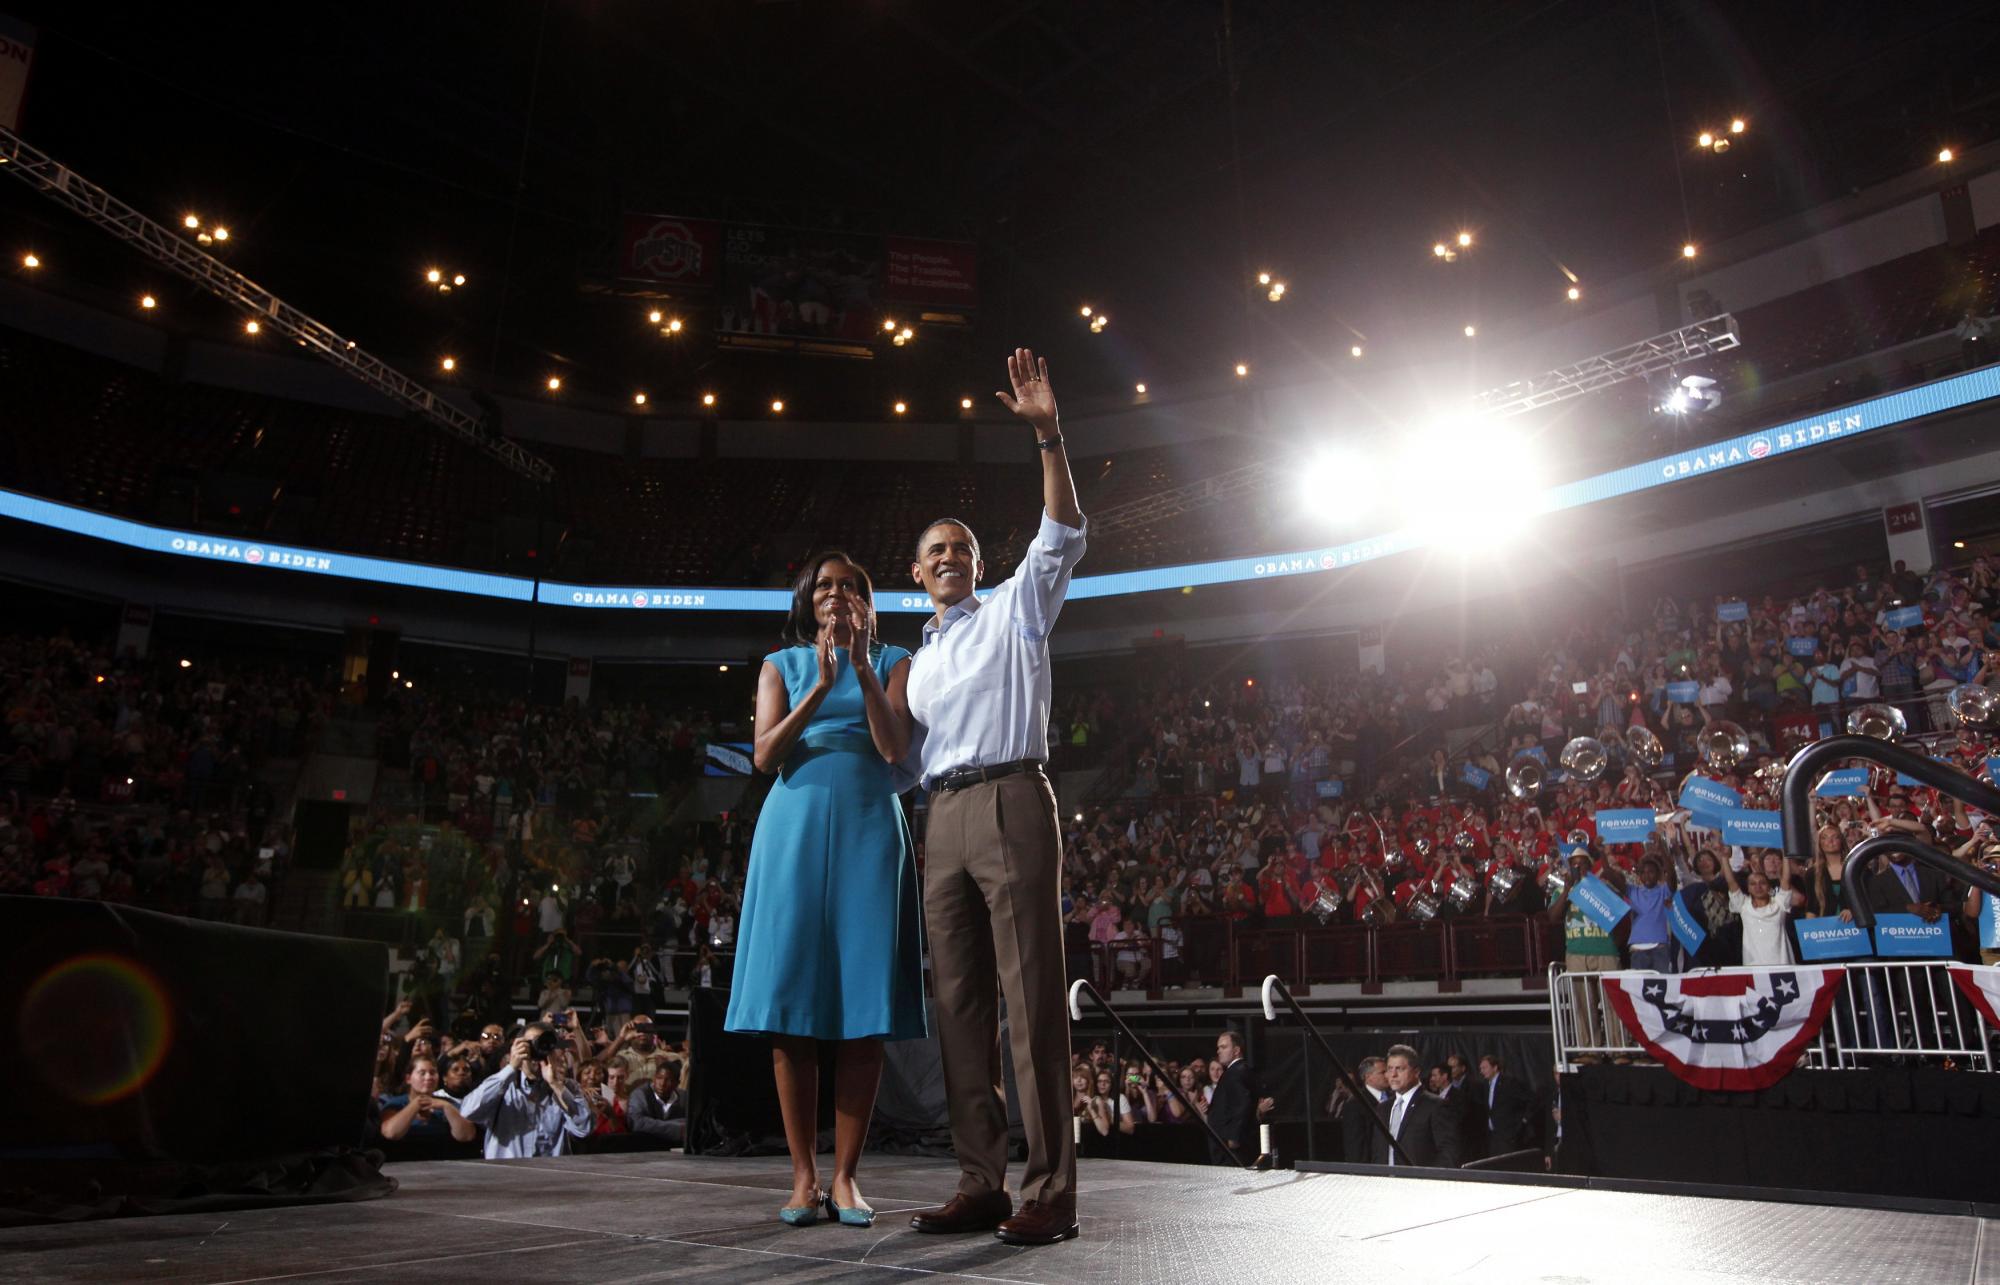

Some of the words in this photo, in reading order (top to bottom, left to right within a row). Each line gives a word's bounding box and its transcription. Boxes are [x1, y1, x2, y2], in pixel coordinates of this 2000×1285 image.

[1663, 447, 1743, 477] OBAMA
[1778, 414, 1862, 449] BIDEN
[1890, 511, 1917, 527] 214
[171, 538, 241, 558] OBAMA
[268, 551, 331, 570] BIDEN
[1254, 558, 1316, 575] OBAMA
[1341, 541, 1394, 562] BIDEN
[572, 592, 629, 605] OBAMA
[652, 594, 705, 606] BIDEN
[901, 596, 935, 608] OBA
